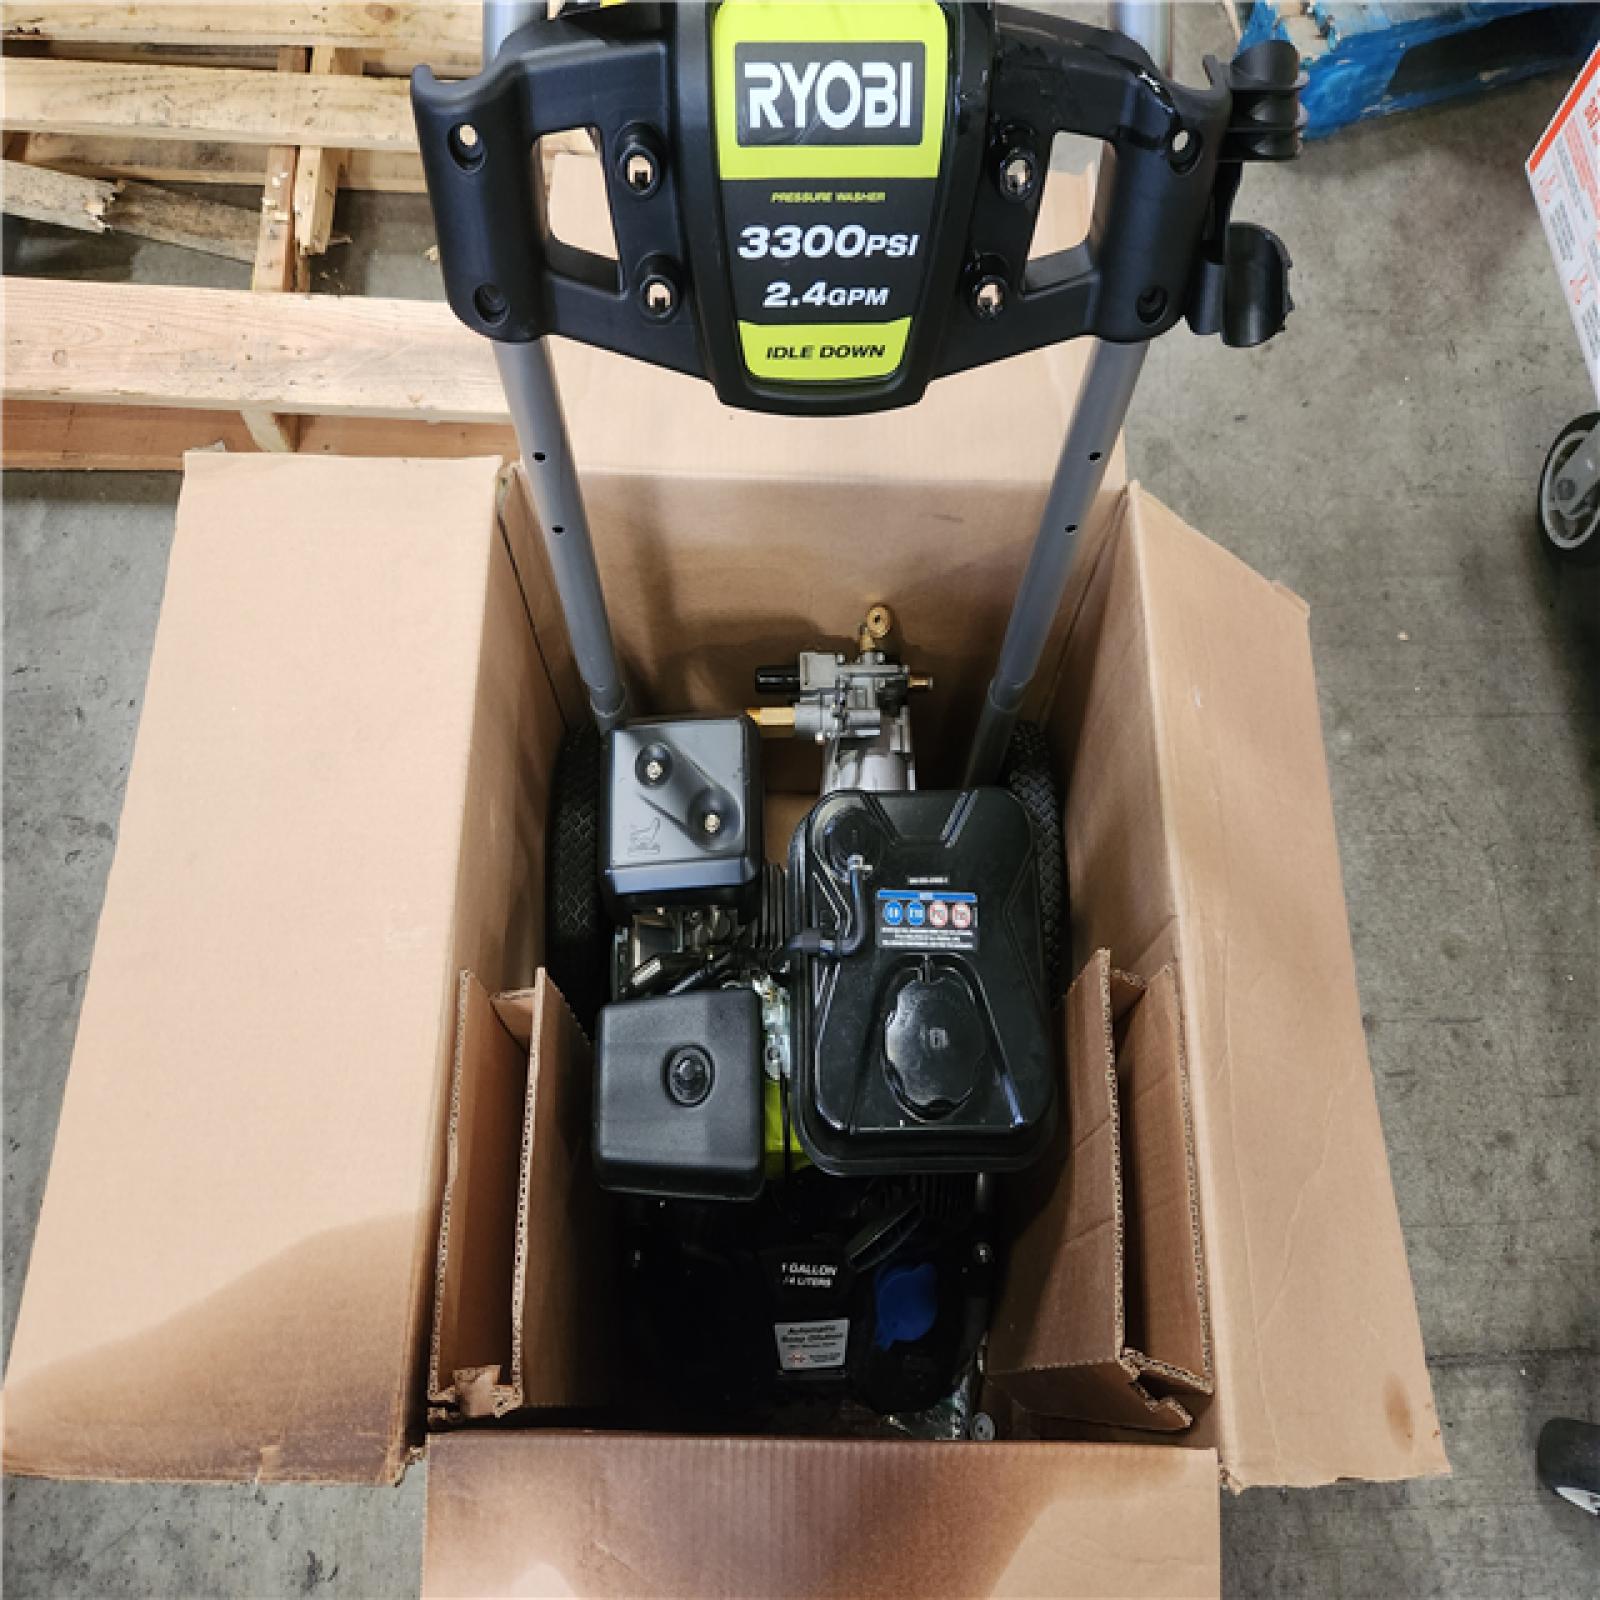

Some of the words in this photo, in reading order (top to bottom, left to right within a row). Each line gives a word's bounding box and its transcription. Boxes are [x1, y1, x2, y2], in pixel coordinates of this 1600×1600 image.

[744, 60, 914, 130] RYOBI
[738, 224, 920, 259] 3300PSI
[763, 281, 890, 307] 2.4GPM
[766, 344, 815, 361] IDLE
[819, 344, 886, 360] DOWN
[789, 1263, 838, 1275] GALLON
